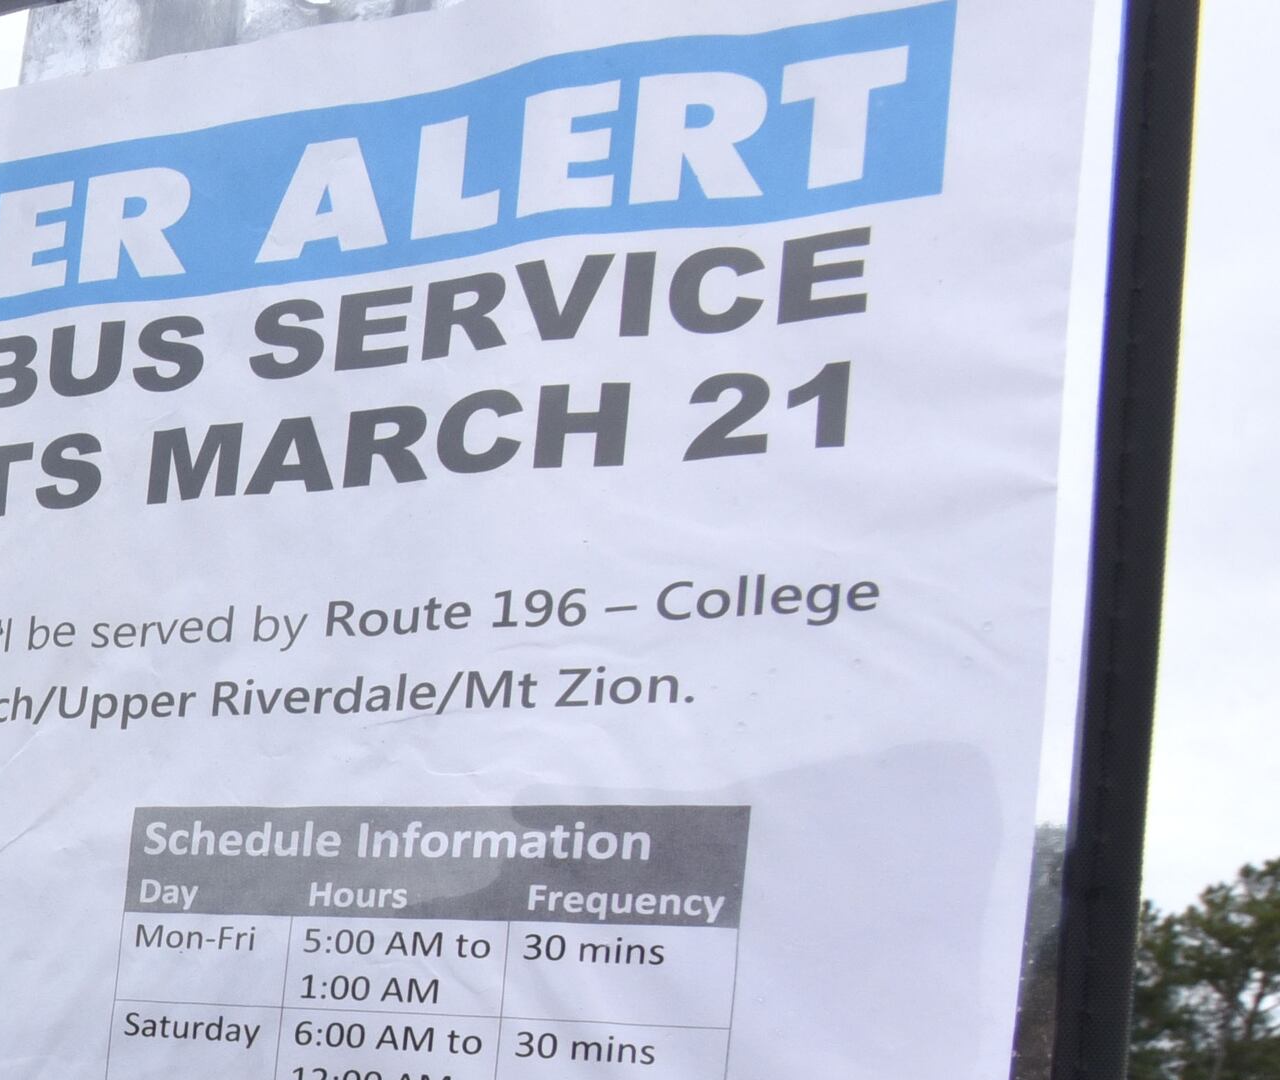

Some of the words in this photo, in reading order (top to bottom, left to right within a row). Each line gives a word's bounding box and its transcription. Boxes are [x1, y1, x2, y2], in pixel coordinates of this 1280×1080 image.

[255, 45, 908, 264] ALERT
[248, 227, 871, 379] SERVICE
[146, 382, 630, 505] MARCH
[683, 361, 850, 462] 21
[28, 615, 76, 650] be
[91, 606, 234, 648] served
[253, 605, 308, 651] by
[325, 596, 471, 637] Route
[491, 587, 587, 628] 196
[657, 574, 879, 626] College
[211, 670, 537, 716] Riverdale/Mt
[555, 666, 695, 707] Zion.
[144, 821, 341, 857] Schedule
[357, 822, 651, 861] Information
[139, 878, 198, 910] Day
[309, 882, 408, 909] Hours
[528, 885, 724, 923] Frequency
[135, 924, 256, 951] Mon-Fri
[303, 928, 374, 956] 5:00
[385, 931, 443, 958] AM
[456, 933, 490, 959] to
[523, 933, 566, 961] 30
[578, 936, 665, 966] mins
[300, 974, 370, 1001] 1:00
[381, 977, 439, 1004] AM
[124, 1012, 260, 1049] Saturday
[294, 1021, 365, 1049] 6:00
[376, 1025, 435, 1052] AM
[447, 1028, 482, 1054] to
[514, 1031, 558, 1060] 30
[570, 1035, 656, 1065] mins
